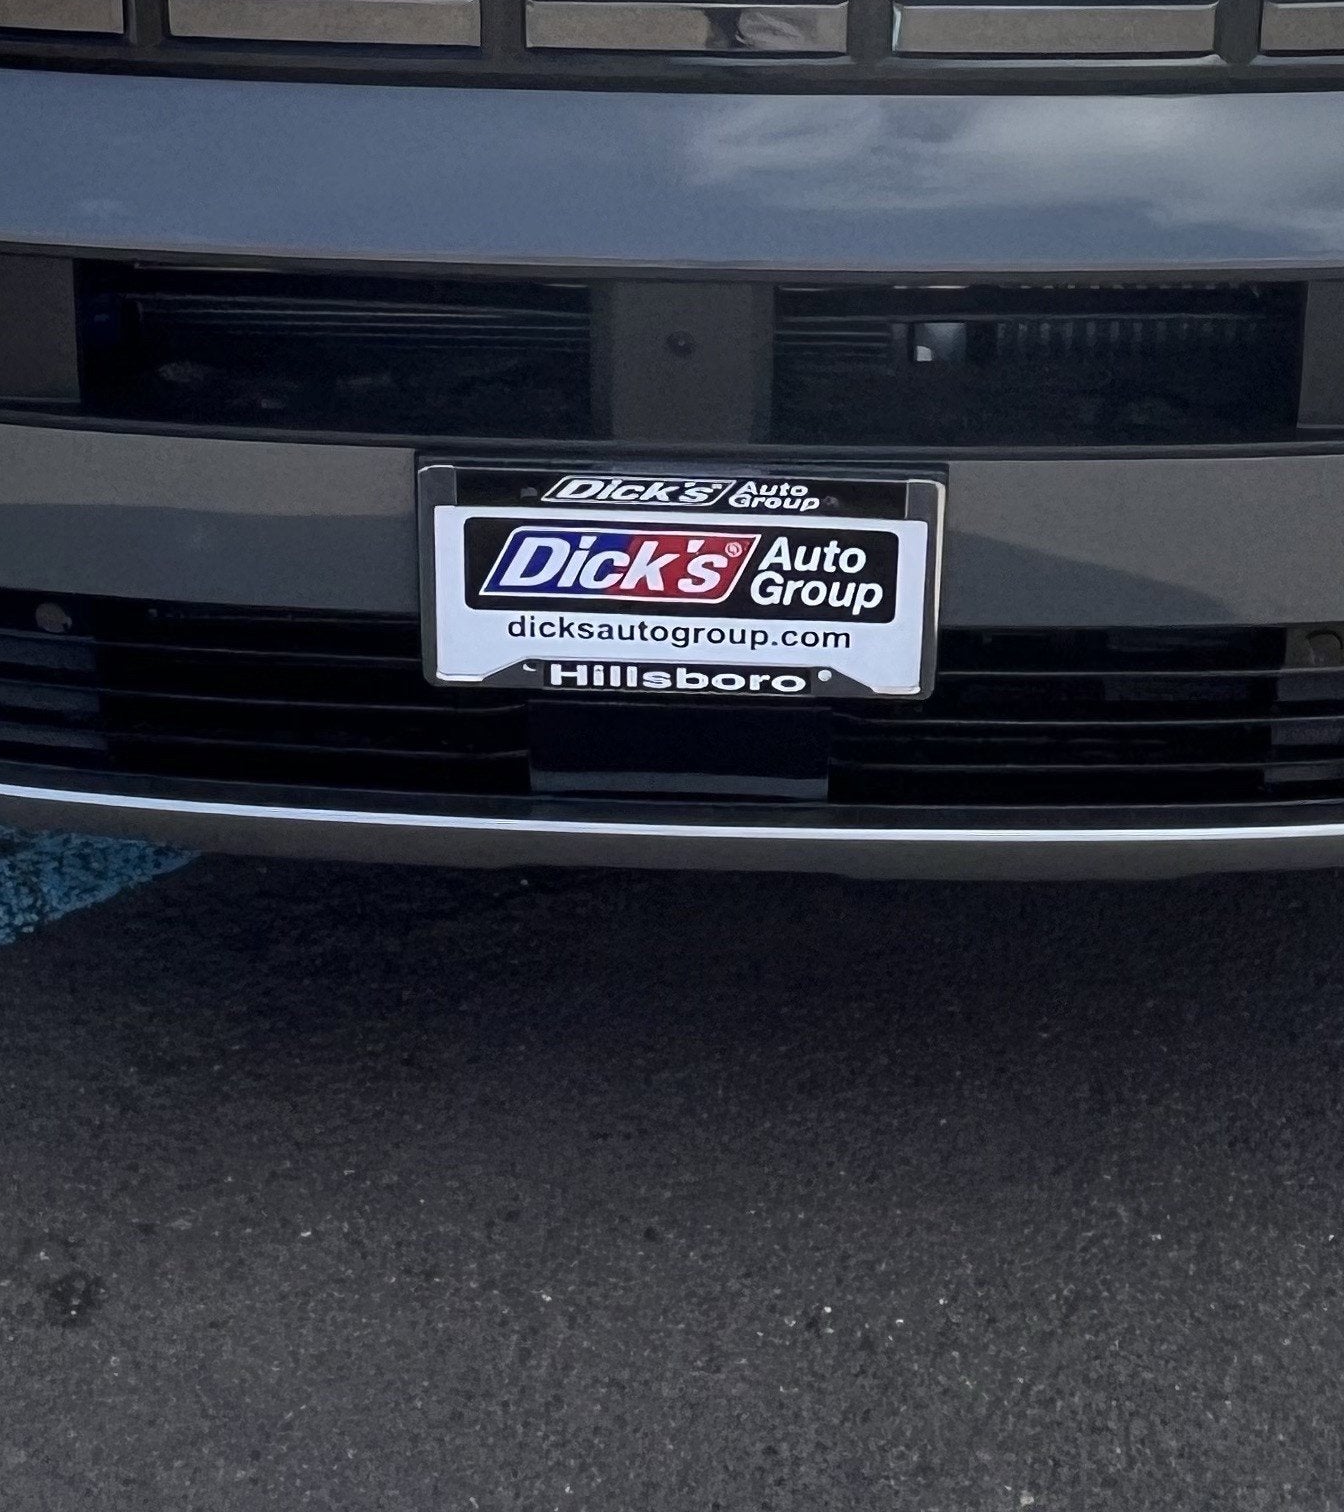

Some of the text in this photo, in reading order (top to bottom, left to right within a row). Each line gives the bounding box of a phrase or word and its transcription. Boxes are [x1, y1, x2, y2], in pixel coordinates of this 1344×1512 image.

[728, 494, 820, 512] Group
[735, 480, 809, 497] Auto
[498, 535, 728, 594] Dick's
[758, 536, 867, 574] Auto
[750, 570, 884, 616] Group
[507, 615, 851, 650] dicksautogroup.com
[549, 664, 807, 693] Hillsboro
